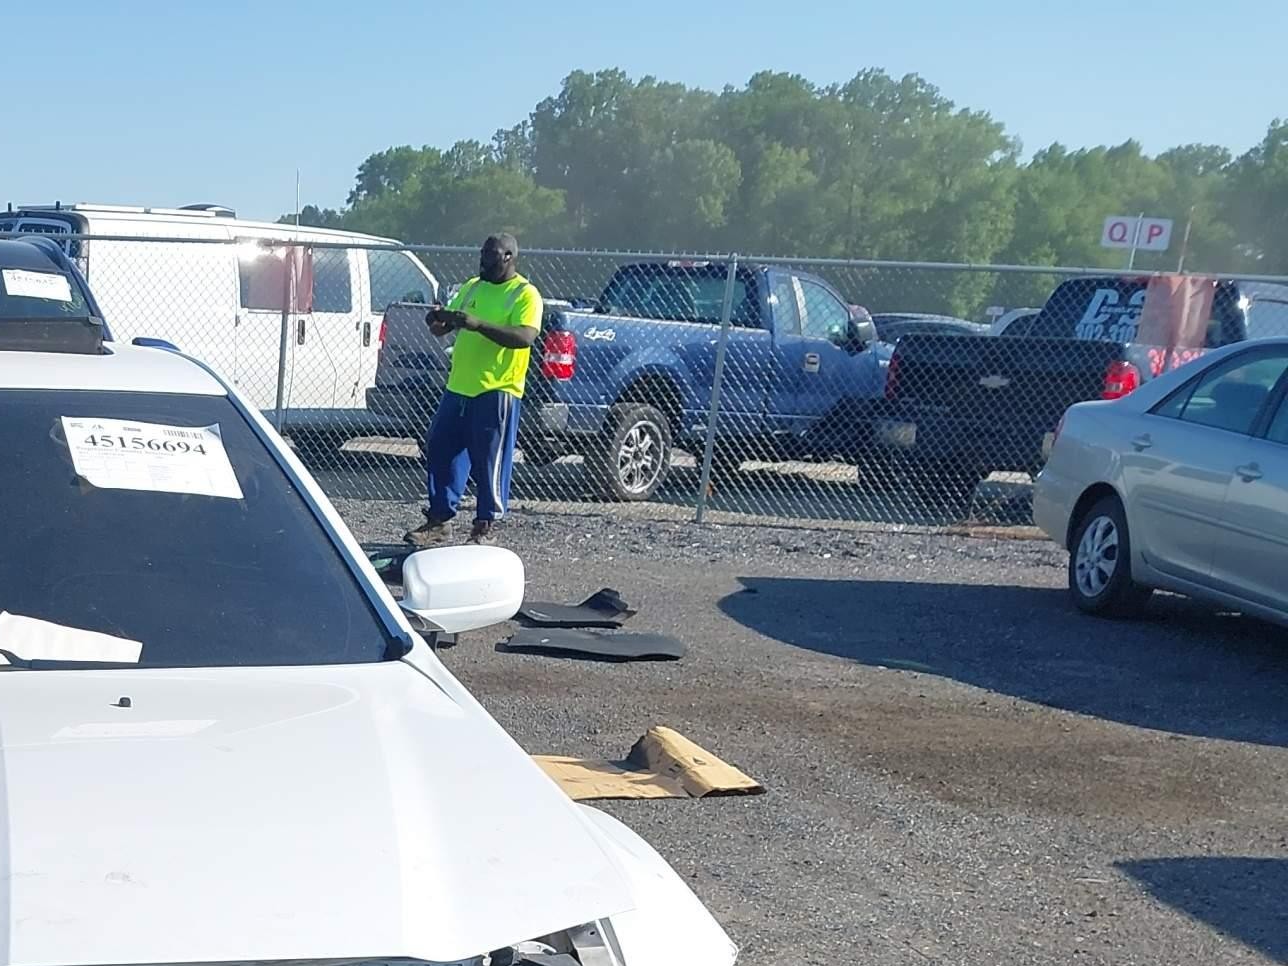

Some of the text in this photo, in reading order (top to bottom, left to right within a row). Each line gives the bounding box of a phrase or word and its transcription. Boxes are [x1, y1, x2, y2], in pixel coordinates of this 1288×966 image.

[1108, 221, 1164, 245] Q P
[83, 433, 209, 456] 45156694
